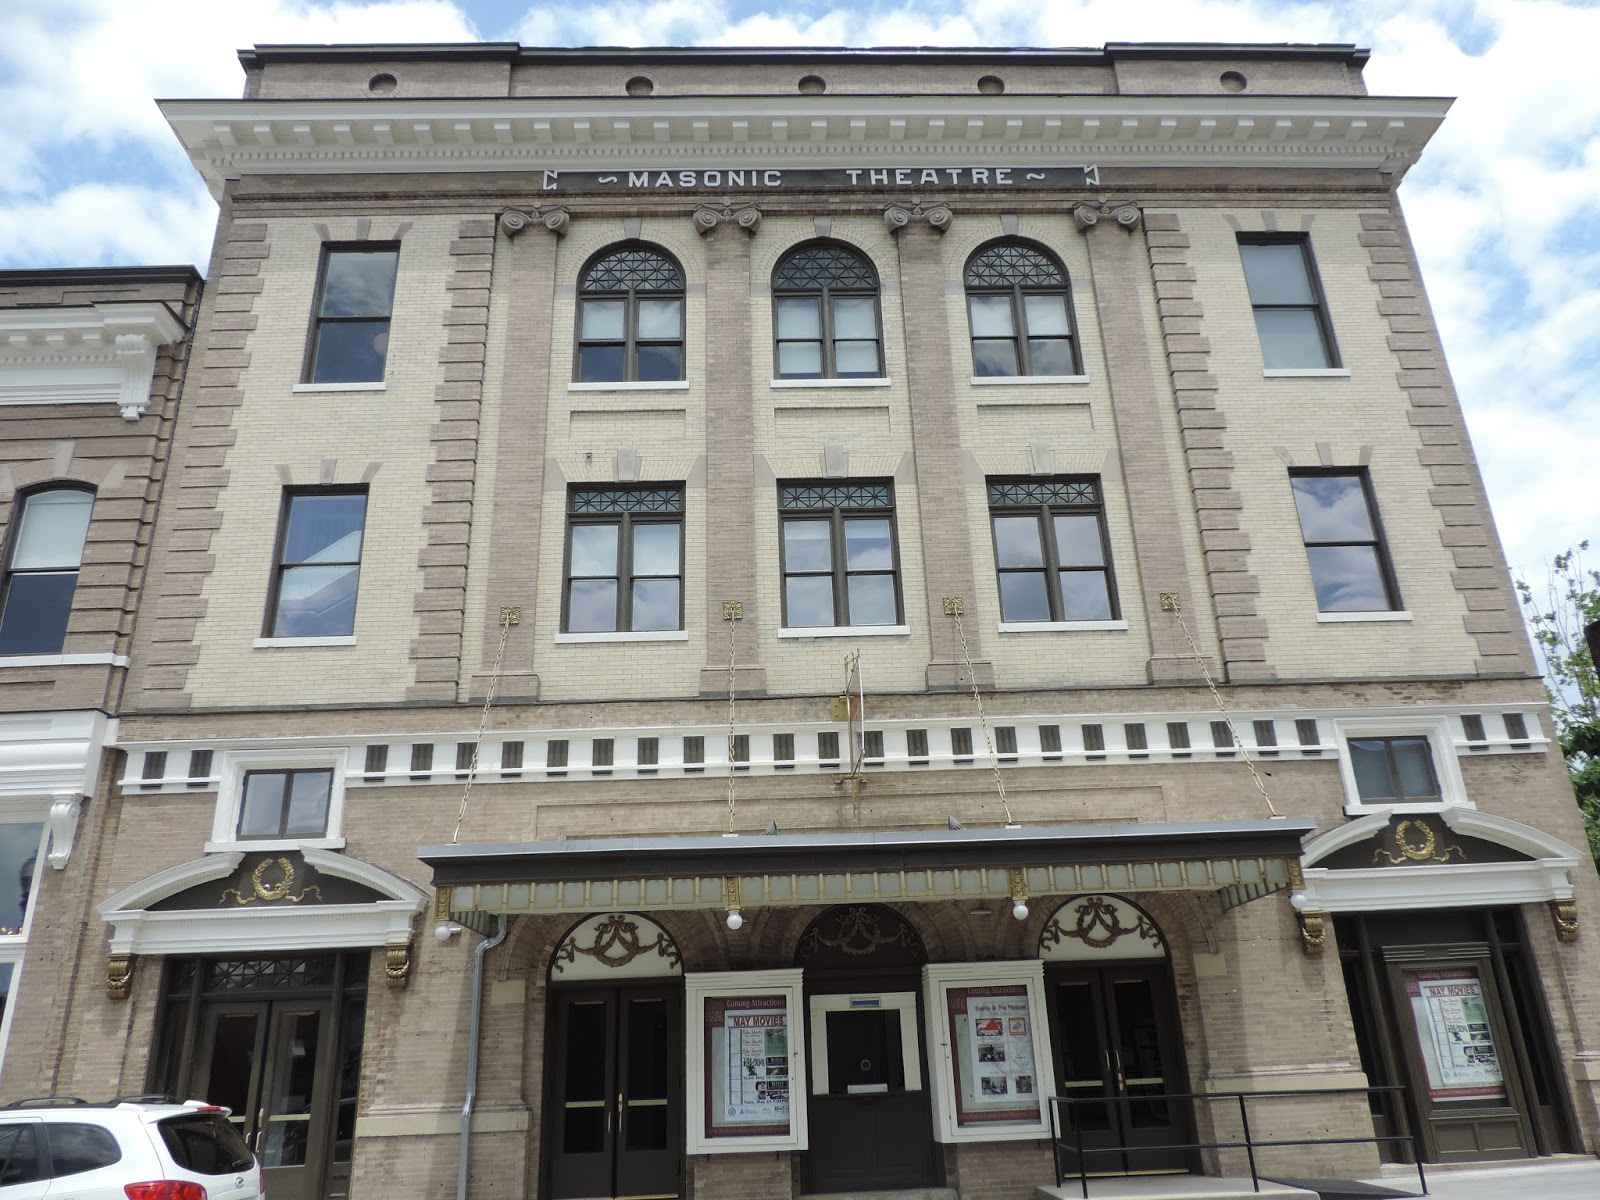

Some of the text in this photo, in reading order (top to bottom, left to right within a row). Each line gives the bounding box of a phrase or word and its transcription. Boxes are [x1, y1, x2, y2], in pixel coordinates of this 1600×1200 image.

[628, 168, 1013, 188] MASONIC THEATRE
[1429, 985, 1476, 997] MAY MOVIES
[727, 998, 785, 1009] Coming Attractions
[733, 1015, 784, 1027] MAY MOVIES
